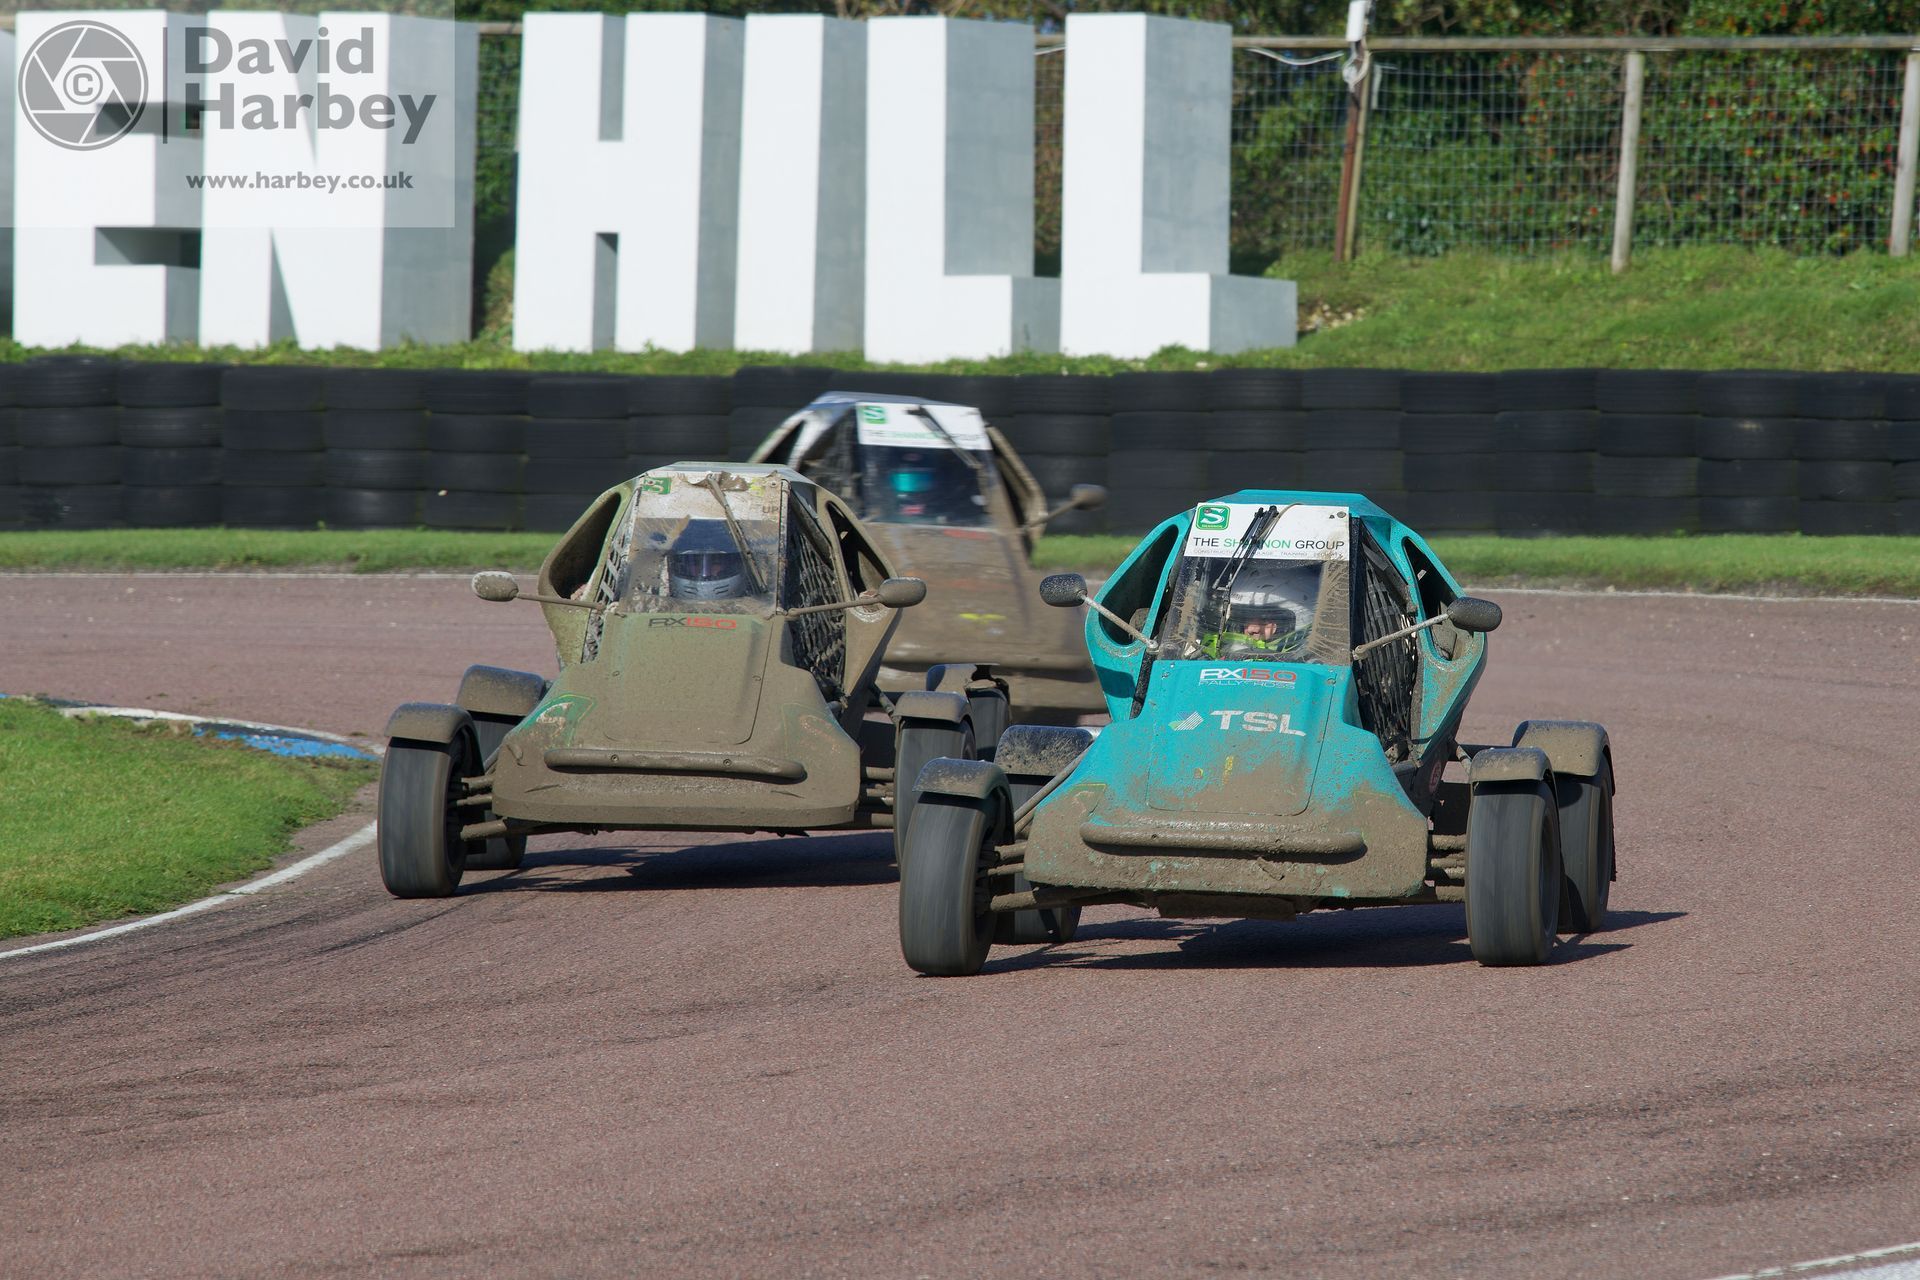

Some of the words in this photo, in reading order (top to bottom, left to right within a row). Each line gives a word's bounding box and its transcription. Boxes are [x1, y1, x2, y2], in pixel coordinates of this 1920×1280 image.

[513, 12, 1213, 364] HILL
[1193, 537, 1220, 547] THE
[1223, 538, 1291, 549] SHNON
[1295, 540, 1345, 550] GROUP
[648, 616, 737, 631] RX150
[1199, 667, 1298, 682] RX150
[1198, 679, 1296, 690] RALLYROSS
[1210, 709, 1307, 737] TSL
